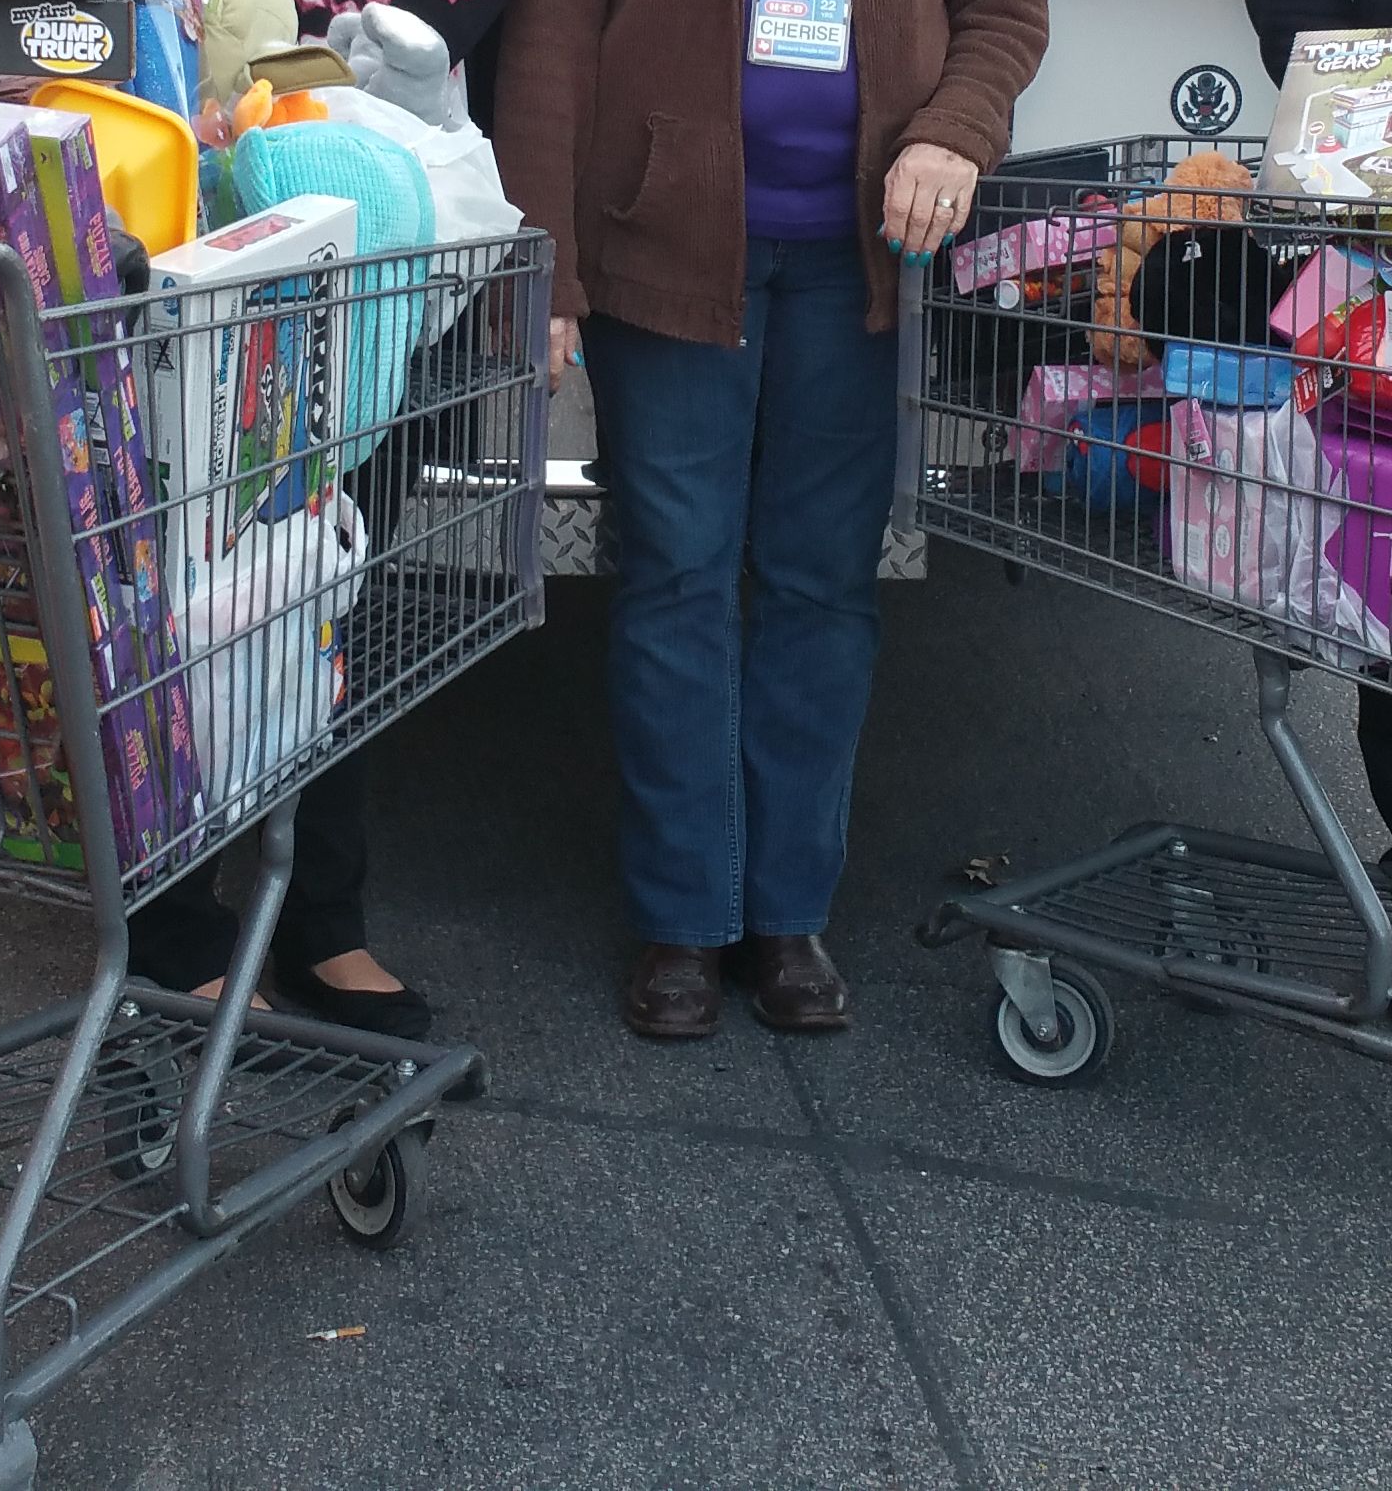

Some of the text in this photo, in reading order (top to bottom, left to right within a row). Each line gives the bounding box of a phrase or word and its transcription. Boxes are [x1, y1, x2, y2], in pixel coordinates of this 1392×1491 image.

[820, 0, 837, 12] 22
[34, 20, 106, 42] DUMP
[760, 19, 840, 43] CHERISE
[27, 38, 106, 62] TRUCK
[1316, 54, 1383, 73] GEARS
[89, 211, 114, 276] PUZZLE
[215, 385, 227, 442] THEM
